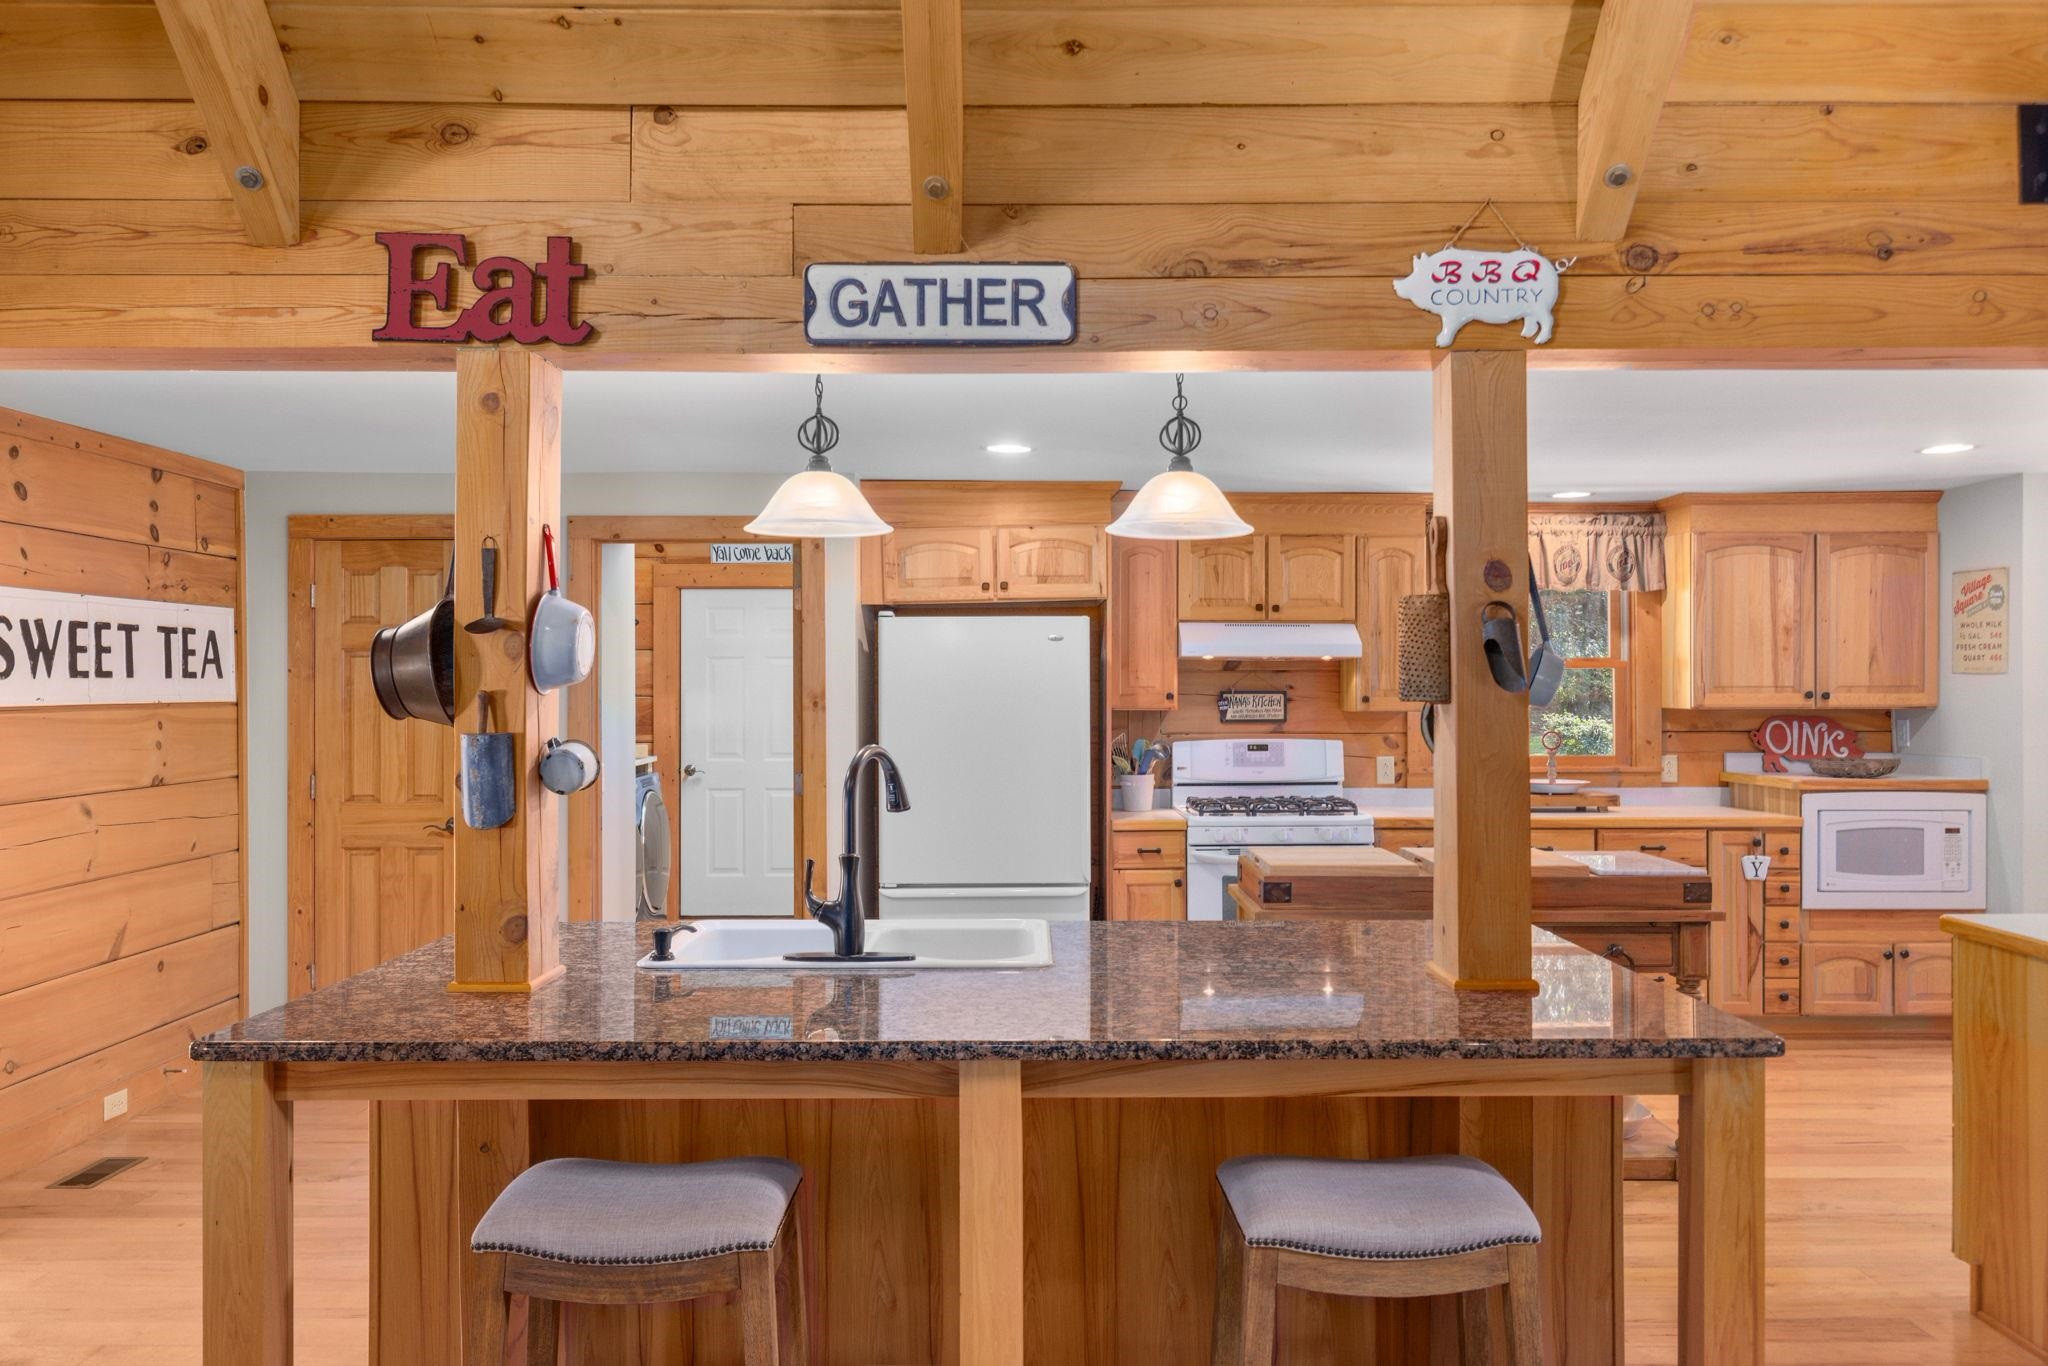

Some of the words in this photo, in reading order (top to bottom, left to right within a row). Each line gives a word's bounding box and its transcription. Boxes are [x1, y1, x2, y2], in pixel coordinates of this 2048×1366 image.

[372, 232, 594, 345] Eat
[1430, 288, 1543, 306] COUNTRY
[829, 277, 1048, 327] GATHER
[764, 545, 791, 561] back
[1960, 574, 1992, 596] Village
[1960, 621, 1983, 629] WHOLE
[1985, 620, 2002, 629] MILK
[157, 625, 223, 679] TEA
[1956, 643, 1976, 651] FRESH
[1978, 642, 2002, 651] CREAM
[1963, 654, 1985, 662] QUART
[1765, 720, 1849, 757] OINK
[1751, 861, 1763, 877] Y
